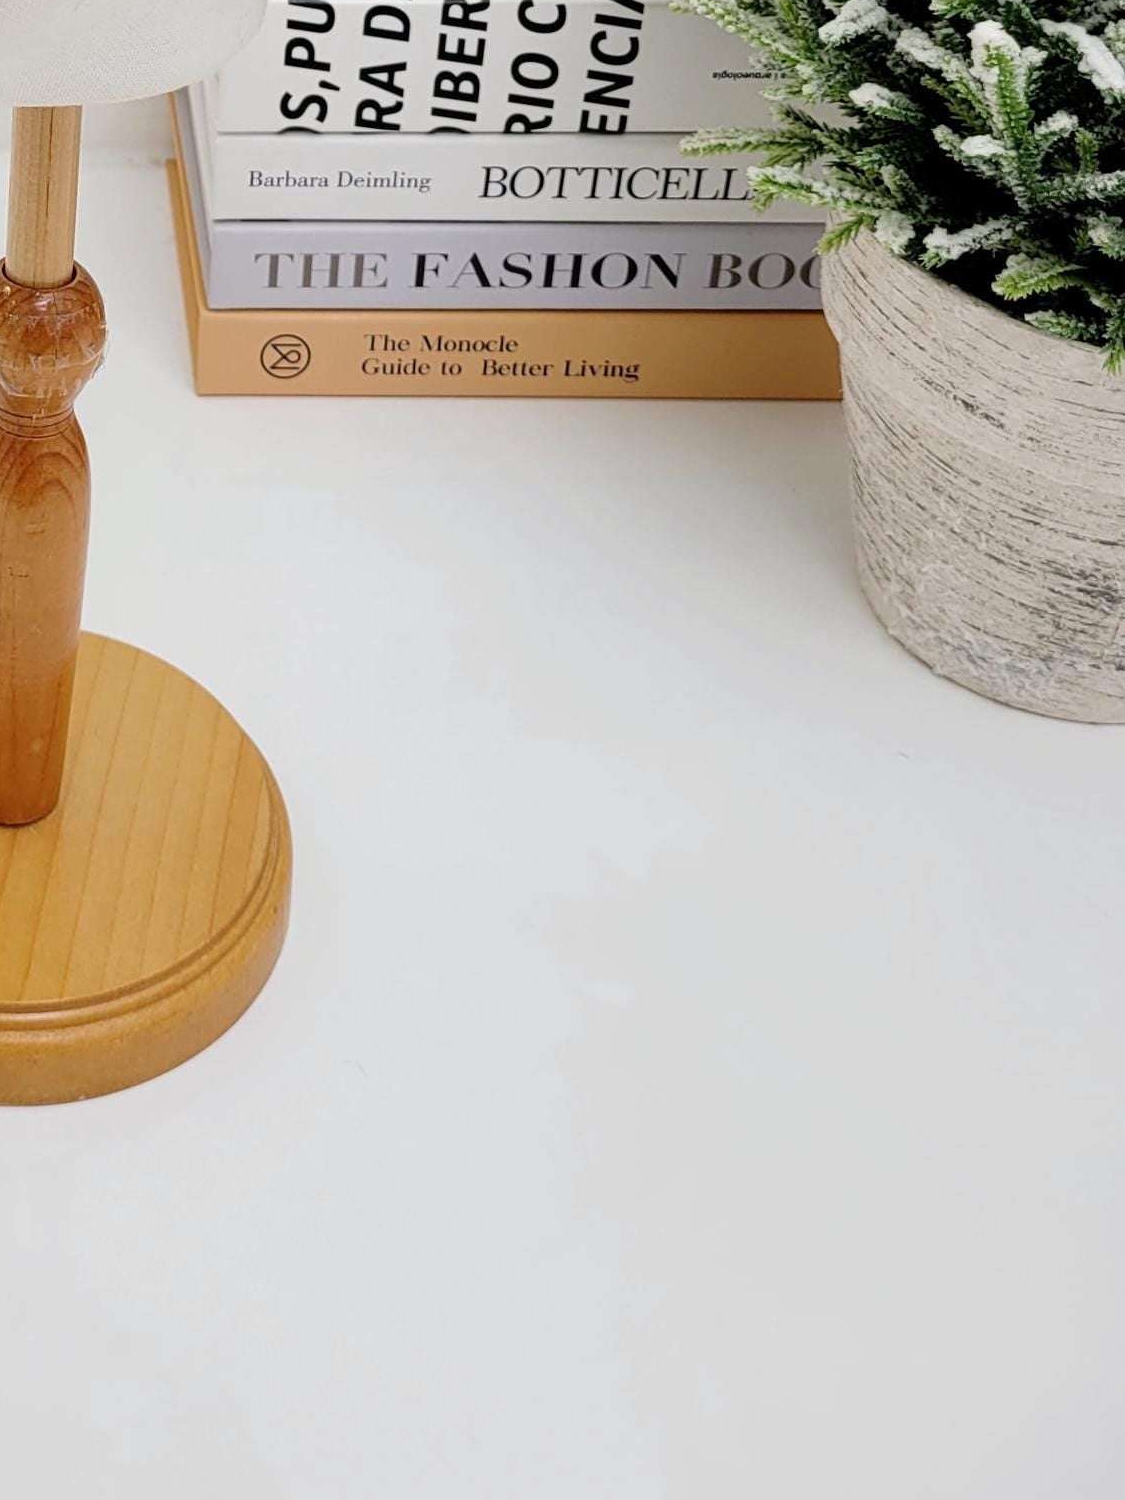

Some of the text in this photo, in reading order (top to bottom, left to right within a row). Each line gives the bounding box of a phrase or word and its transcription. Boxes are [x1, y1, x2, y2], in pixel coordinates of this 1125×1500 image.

[278, 79, 342, 134] S,
[355, 61, 407, 131] RA
[503, 52, 560, 134] RIO
[248, 165, 755, 201] Barbara Deimling BOTTICELL
[254, 253, 388, 288] THE
[410, 252, 688, 289] FASHON
[364, 333, 518, 353] The Monocle
[362, 357, 640, 382] Guide to Better Living
